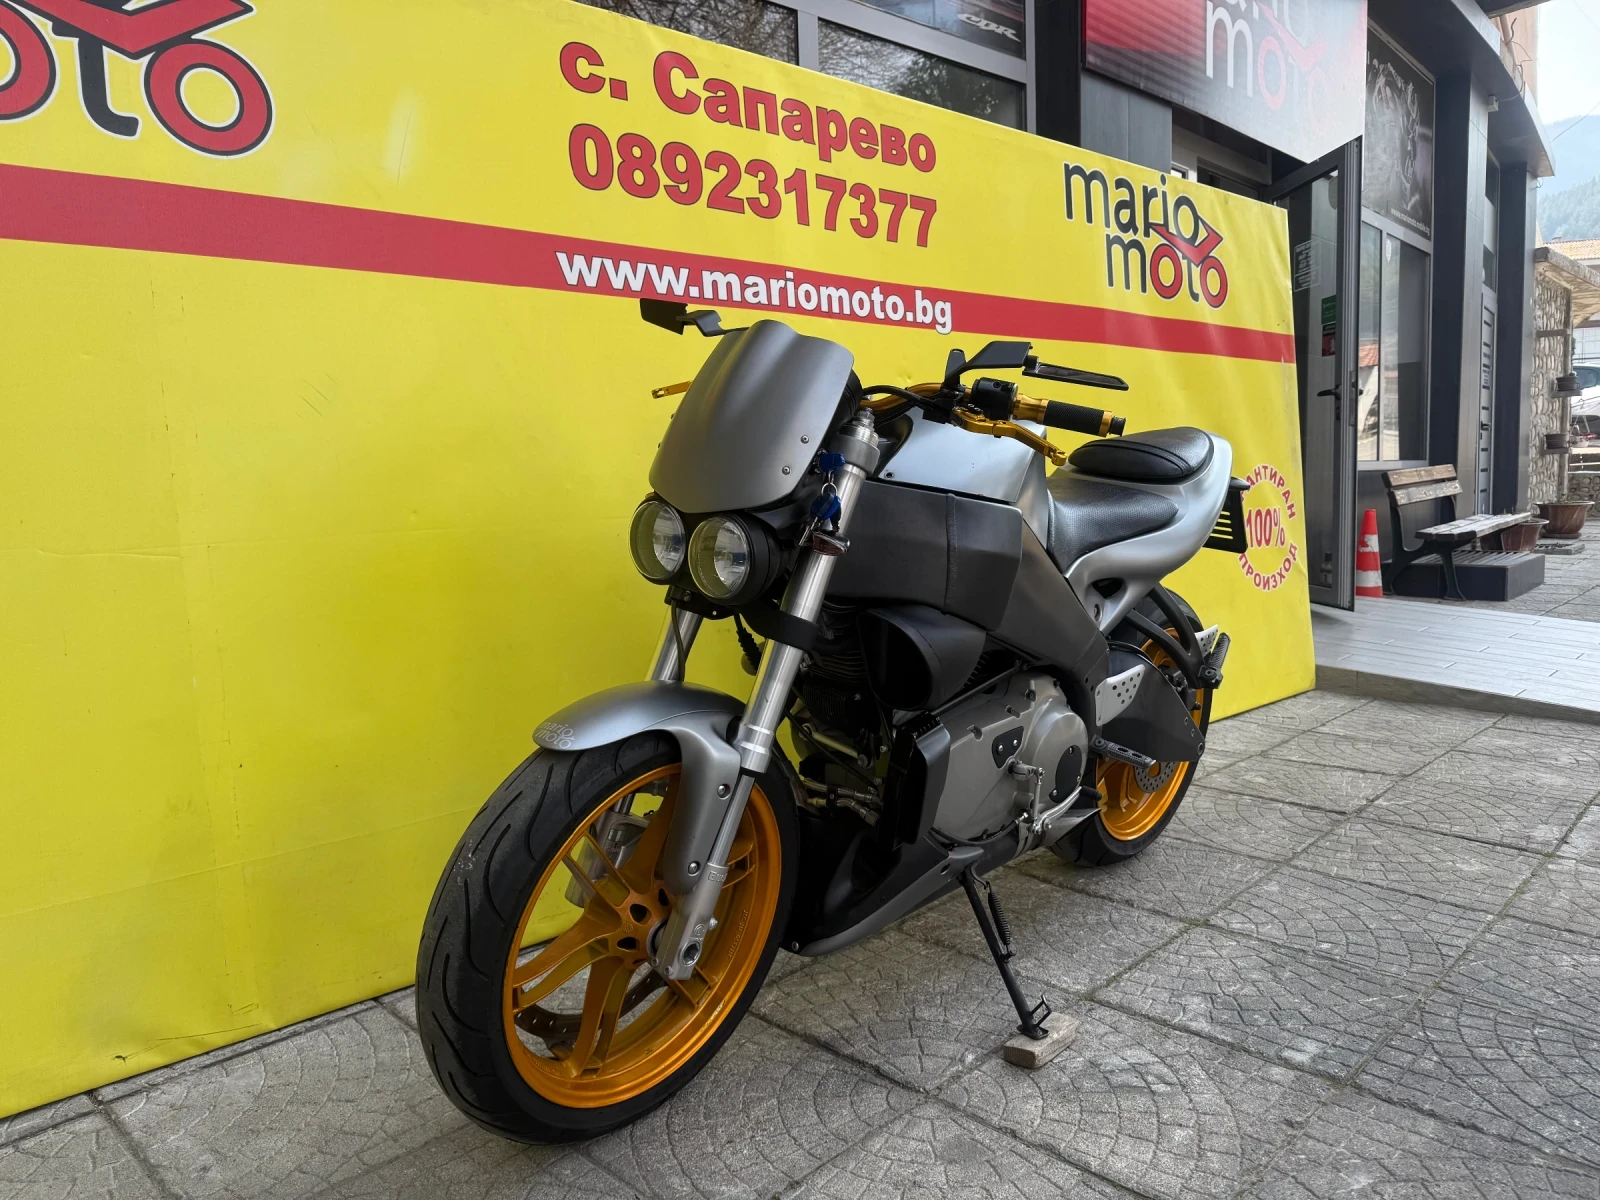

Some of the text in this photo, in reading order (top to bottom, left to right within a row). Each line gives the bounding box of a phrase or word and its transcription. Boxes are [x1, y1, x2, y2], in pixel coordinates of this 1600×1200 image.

[957, 13, 1021, 42] CBR
[560, 42, 936, 172] с. Сапарево
[568, 123, 937, 247] 0892317377
[1064, 162, 1199, 246] mario
[555, 251, 953, 335] www.mariomoto.bg
[1106, 233, 1228, 308] moto
[1239, 543, 1297, 590] ПРОИЗХОД
[1246, 508, 1285, 547] 100%
